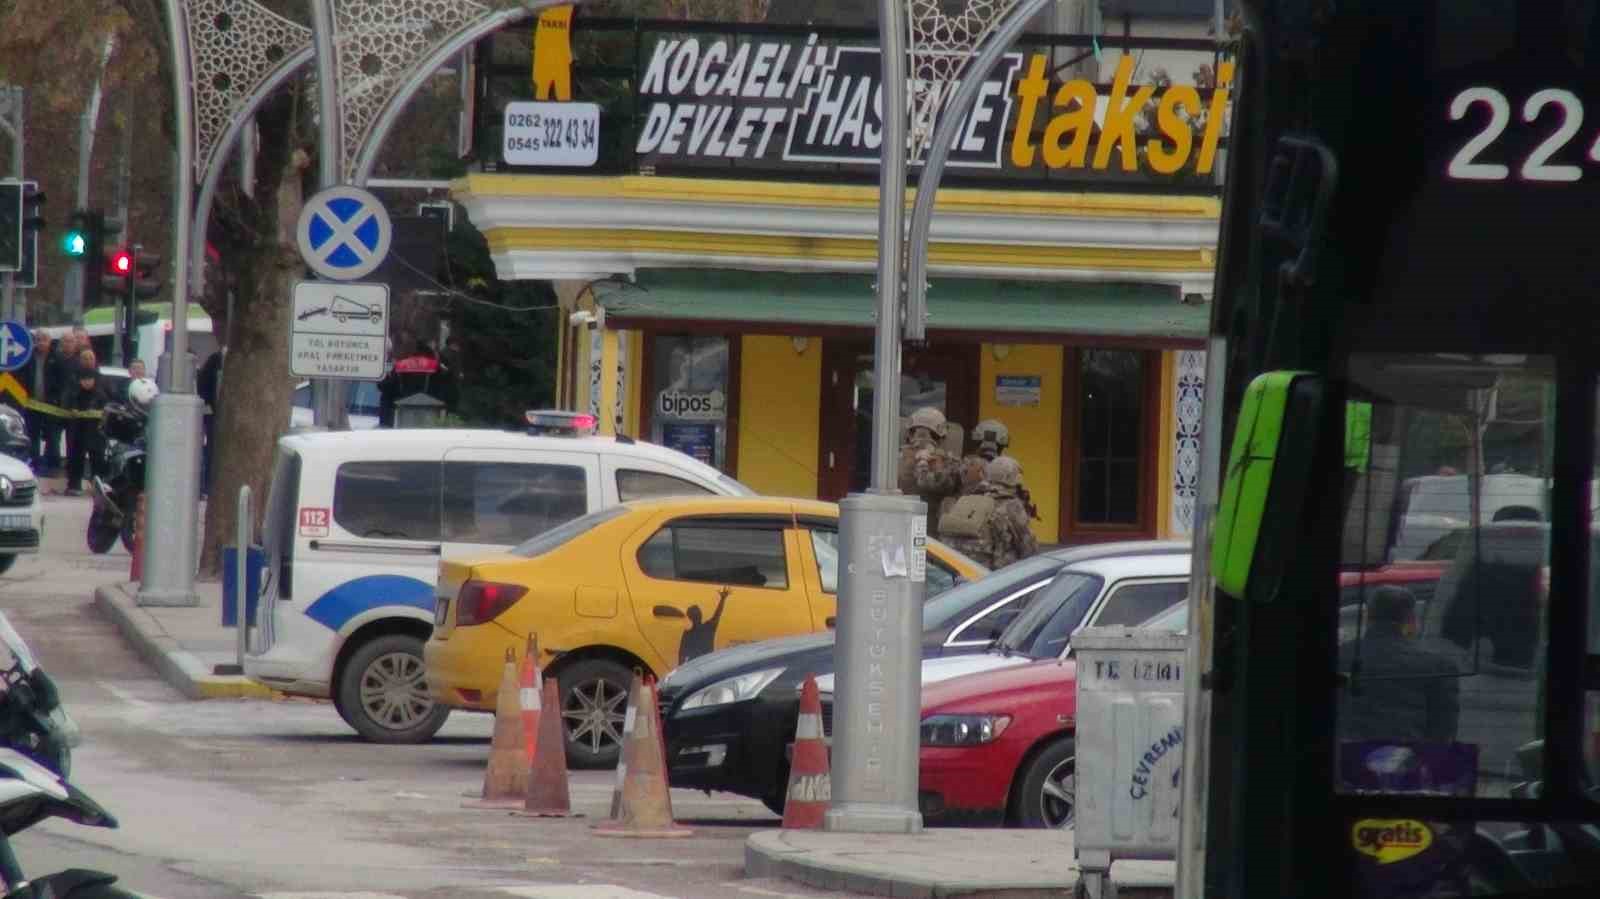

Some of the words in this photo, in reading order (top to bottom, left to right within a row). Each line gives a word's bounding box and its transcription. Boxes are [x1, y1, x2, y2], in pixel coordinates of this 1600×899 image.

[640, 32, 818, 98] KOCAELİ
[508, 113, 542, 128] 0262
[1010, 52, 1236, 175] taksi
[507, 136, 541, 151] 0545
[543, 117, 563, 149] 322
[566, 117, 579, 150] 43
[581, 118, 595, 150] 34
[635, 103, 788, 158] DEVLET
[1449, 86, 1600, 181] 22
[661, 392, 712, 416] bipos
[303, 510, 326, 526] 112
